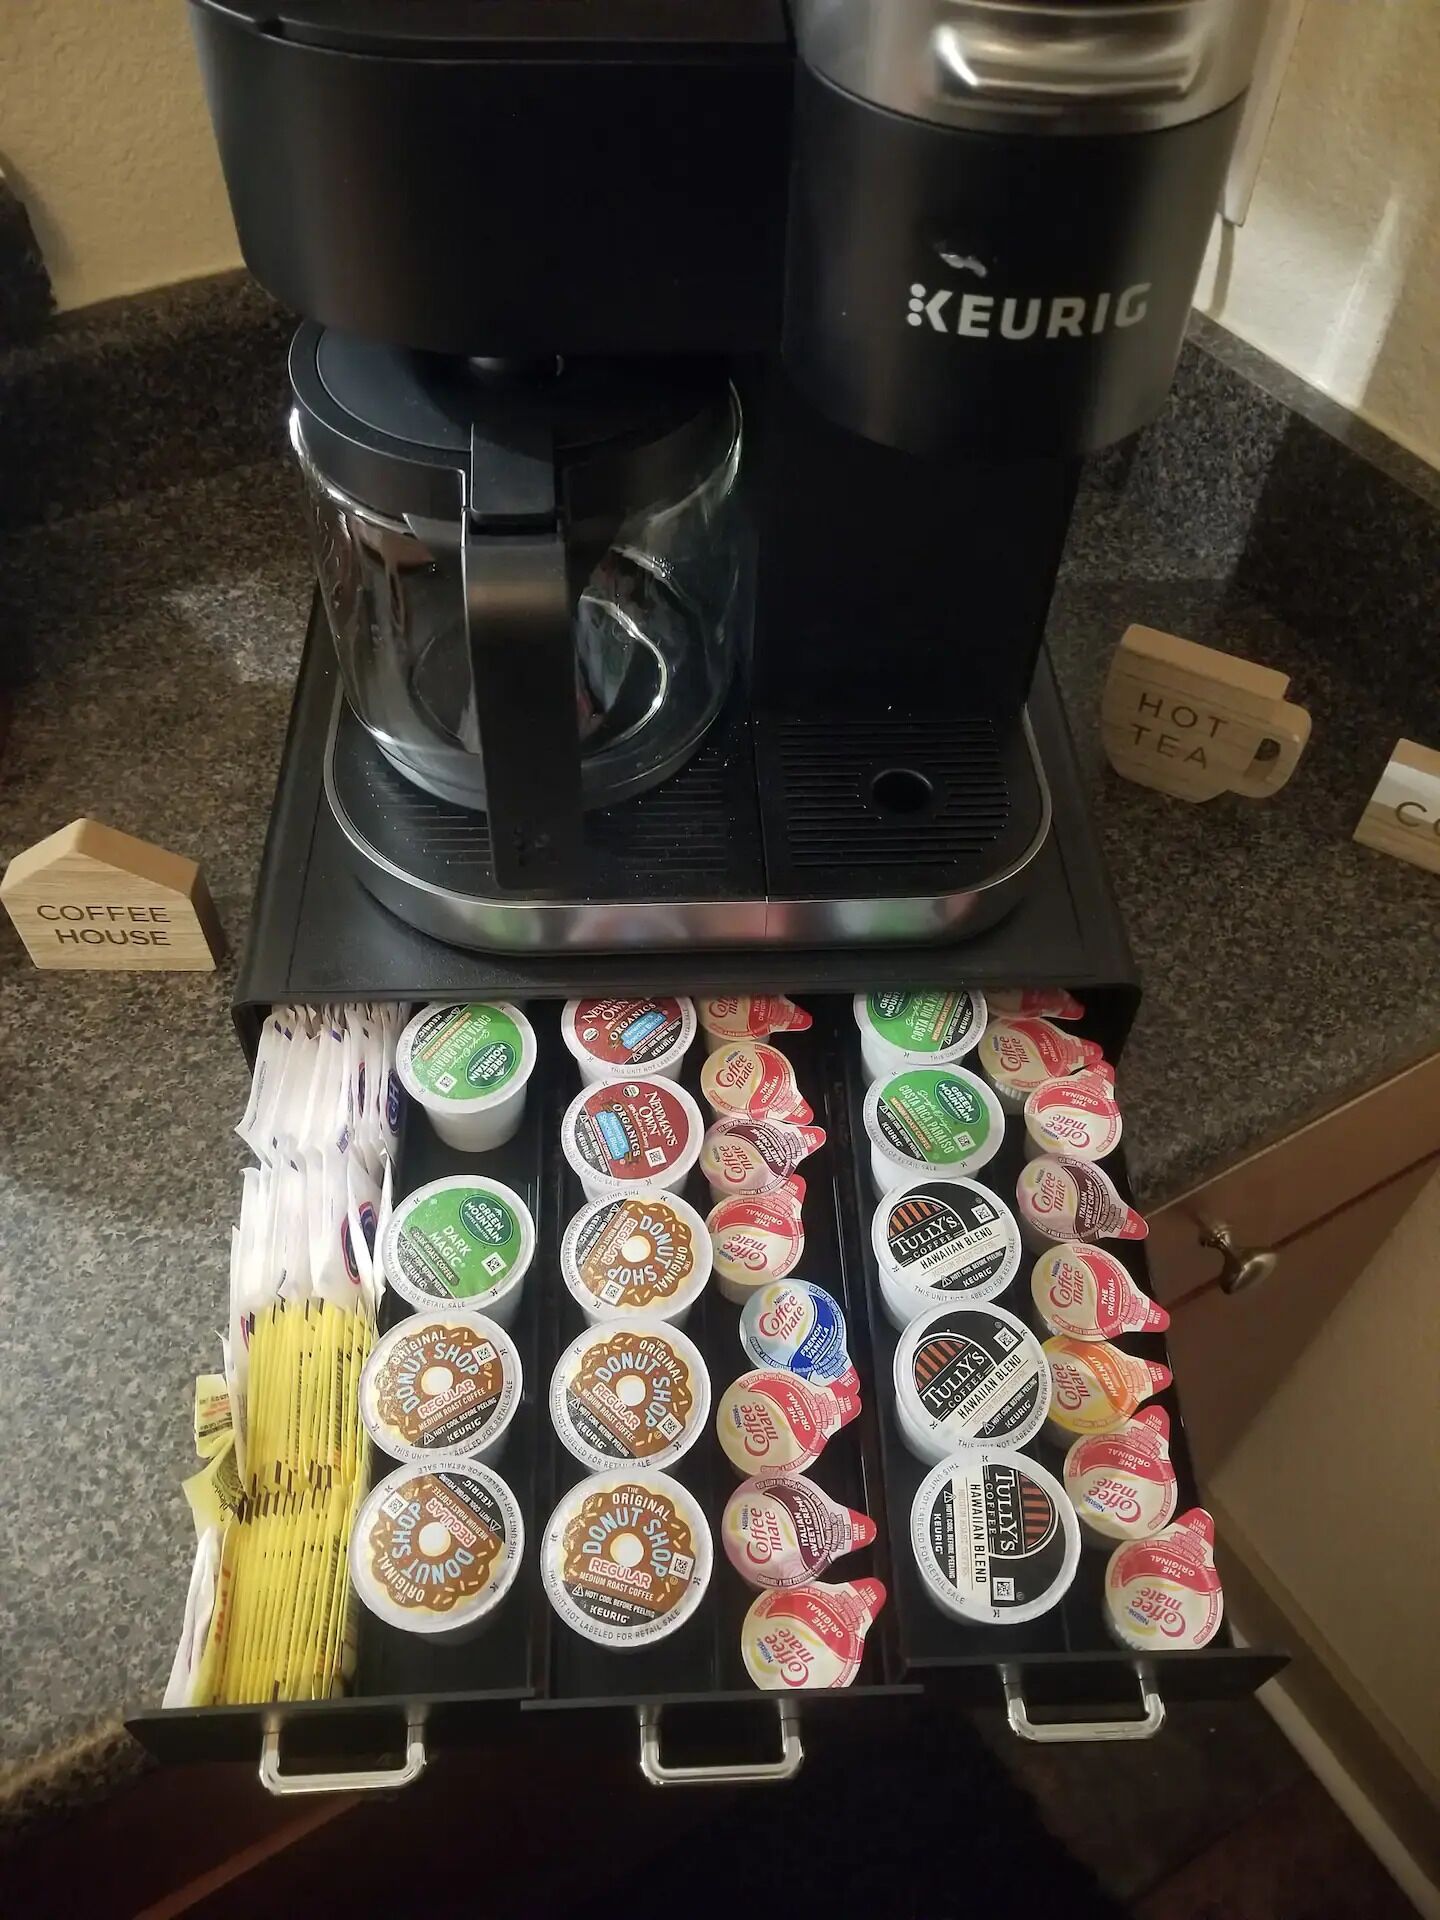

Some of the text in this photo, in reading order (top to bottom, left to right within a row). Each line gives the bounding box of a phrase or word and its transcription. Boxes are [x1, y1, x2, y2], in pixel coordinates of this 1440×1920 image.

[906, 282, 1152, 340] KEURIG
[1138, 693, 1228, 738] HOT
[1131, 724, 1207, 769] TEA
[1395, 801, 1440, 837] C
[37, 905, 171, 922] COFFEE
[55, 929, 171, 945] HOUSE
[610, 1003, 657, 1041] ORGANICS
[469, 1043, 507, 1081] MOUNTAIN
[651, 1035, 676, 1057] KEURIG
[483, 1055, 508, 1080] GREEN
[716, 1055, 747, 1088] Coffee
[735, 1062, 754, 1088] mate
[760, 1082, 771, 1094] THE
[761, 1076, 780, 1103] ORIGINAL
[899, 1085, 918, 1107] COSTA
[916, 1102, 931, 1123] RICA
[938, 1083, 972, 1122] MOUNTAIN
[950, 1087, 975, 1112] GREEN
[612, 1103, 641, 1157] ORGANICS
[639, 1106, 661, 1136] OWN
[645, 1091, 678, 1147] NEWMAN'S
[882, 1122, 902, 1147] KEURIG
[1045, 1121, 1090, 1148] Coffee
[1052, 1114, 1087, 1129] mate
[577, 1131, 590, 1159] KEURIG
[732, 1145, 754, 1170] mate
[720, 1145, 746, 1183] Coffee
[1032, 1172, 1056, 1213] Coffee
[1053, 1180, 1066, 1211] mate
[1079, 1190, 1088, 1219] ITALIAN
[465, 1202, 502, 1242] MOUNTAIN
[478, 1203, 504, 1230] GREEN
[745, 1208, 783, 1225] ORIGINAL
[754, 1218, 771, 1227] THE
[1085, 1203, 1094, 1228] SWEET
[443, 1226, 472, 1256] DARK
[601, 1218, 638, 1265] REGULAR
[639, 1215, 674, 1270] DONUT
[732, 1234, 768, 1251] mate
[890, 1215, 958, 1256] TULLY'S
[913, 1234, 954, 1258] COFFEE
[920, 1227, 993, 1270] HAWAIIAN BLEND
[653, 1246, 688, 1292] ORIGINAL
[723, 1242, 768, 1271] Coffee
[607, 1264, 658, 1287] SHOP
[963, 1267, 991, 1287] KEURIG
[1049, 1263, 1073, 1308] Coffee
[1073, 1270, 1084, 1305] mate
[1101, 1288, 1109, 1305] THE
[759, 1296, 798, 1336] Coffee
[780, 1306, 805, 1341] mate
[392, 1330, 447, 1365] ORIGINAL
[656, 1340, 666, 1349] THE
[801, 1324, 822, 1356] FRENCH
[806, 1328, 830, 1359] VANILLA
[433, 1342, 480, 1376] SHOP
[595, 1352, 661, 1383] DONUT
[639, 1340, 685, 1384] ORIGINAL
[396, 1348, 428, 1414] DONUT
[922, 1351, 986, 1409] TULLY'S
[948, 1372, 984, 1409] COFFEE
[957, 1354, 1022, 1420] HAWAIIAN BLEND
[1052, 1363, 1082, 1410] Coffee
[1067, 1366, 1090, 1398] mate
[418, 1379, 476, 1419] REGULAR
[418, 1387, 487, 1431] MEDIUM ROAST COFFEE
[581, 1388, 636, 1443] MEDIUM ROAST COFFEE
[592, 1382, 641, 1431] REGULAR
[644, 1376, 672, 1427] SHOP
[786, 1392, 811, 1431] ORIGINAL
[787, 1406, 800, 1424] THE
[1005, 1400, 1031, 1429] KEURIG
[447, 1418, 482, 1442] KEURIG
[576, 1421, 606, 1449] KEURIG
[741, 1405, 770, 1457] Coffee
[755, 1404, 778, 1440] mate
[1107, 1448, 1151, 1468] ORIGINAL
[1118, 1457, 1137, 1470] THE
[463, 1479, 494, 1508] KEURIG
[627, 1486, 639, 1494] THE
[1088, 1487, 1141, 1523] Coffee
[1098, 1478, 1138, 1498] mate
[425, 1497, 477, 1548] REGULAR
[431, 1485, 488, 1540] MEDIUM ROAST COFFEE
[612, 1493, 672, 1522] ORIGINAL
[985, 1482, 997, 1535] COFFEE
[995, 1469, 1019, 1552] TULLY'S
[391, 1501, 422, 1559] SHOP
[582, 1506, 644, 1555] DONUT
[747, 1508, 772, 1564] Coffee
[766, 1511, 783, 1551] mate
[795, 1512, 810, 1546] ITALIAN
[807, 1524, 820, 1557] SWEET
[933, 1513, 943, 1553] KEURIG
[969, 1484, 987, 1583] HAWAIIAN BLEND
[400, 1547, 474, 1585] DONUT
[643, 1519, 672, 1578] SHOP
[1150, 1555, 1195, 1576] ORIGINAL
[377, 1552, 425, 1602] ORIGINAL
[588, 1557, 652, 1589] REGULAR
[920, 1545, 930, 1562] FOR
[926, 1563, 946, 1590] RETAIL
[945, 1591, 966, 1605] SALE
[948, 1555, 956, 1579] PEELING
[1162, 1566, 1181, 1578] THE
[580, 1572, 654, 1601] MEDIUM ROAST COFFEE
[1140, 1587, 1183, 1610] mate
[548, 1570, 558, 1589] THIS
[565, 1607, 579, 1623] NOT
[580, 1621, 614, 1640] LABELED
[635, 1624, 662, 1638] RETAIL
[663, 1609, 681, 1626] SALE
[589, 1604, 628, 1623] KEURIG
[599, 1594, 613, 1604] COOL
[613, 1598, 634, 1611] BEFORE
[634, 1604, 655, 1618] PEELING
[806, 1601, 844, 1638] ORIGINAL
[1131, 1597, 1186, 1638] Coffee
[811, 1617, 829, 1635] THE
[764, 1634, 809, 1687] Coffee
[779, 1628, 815, 1664] mate
